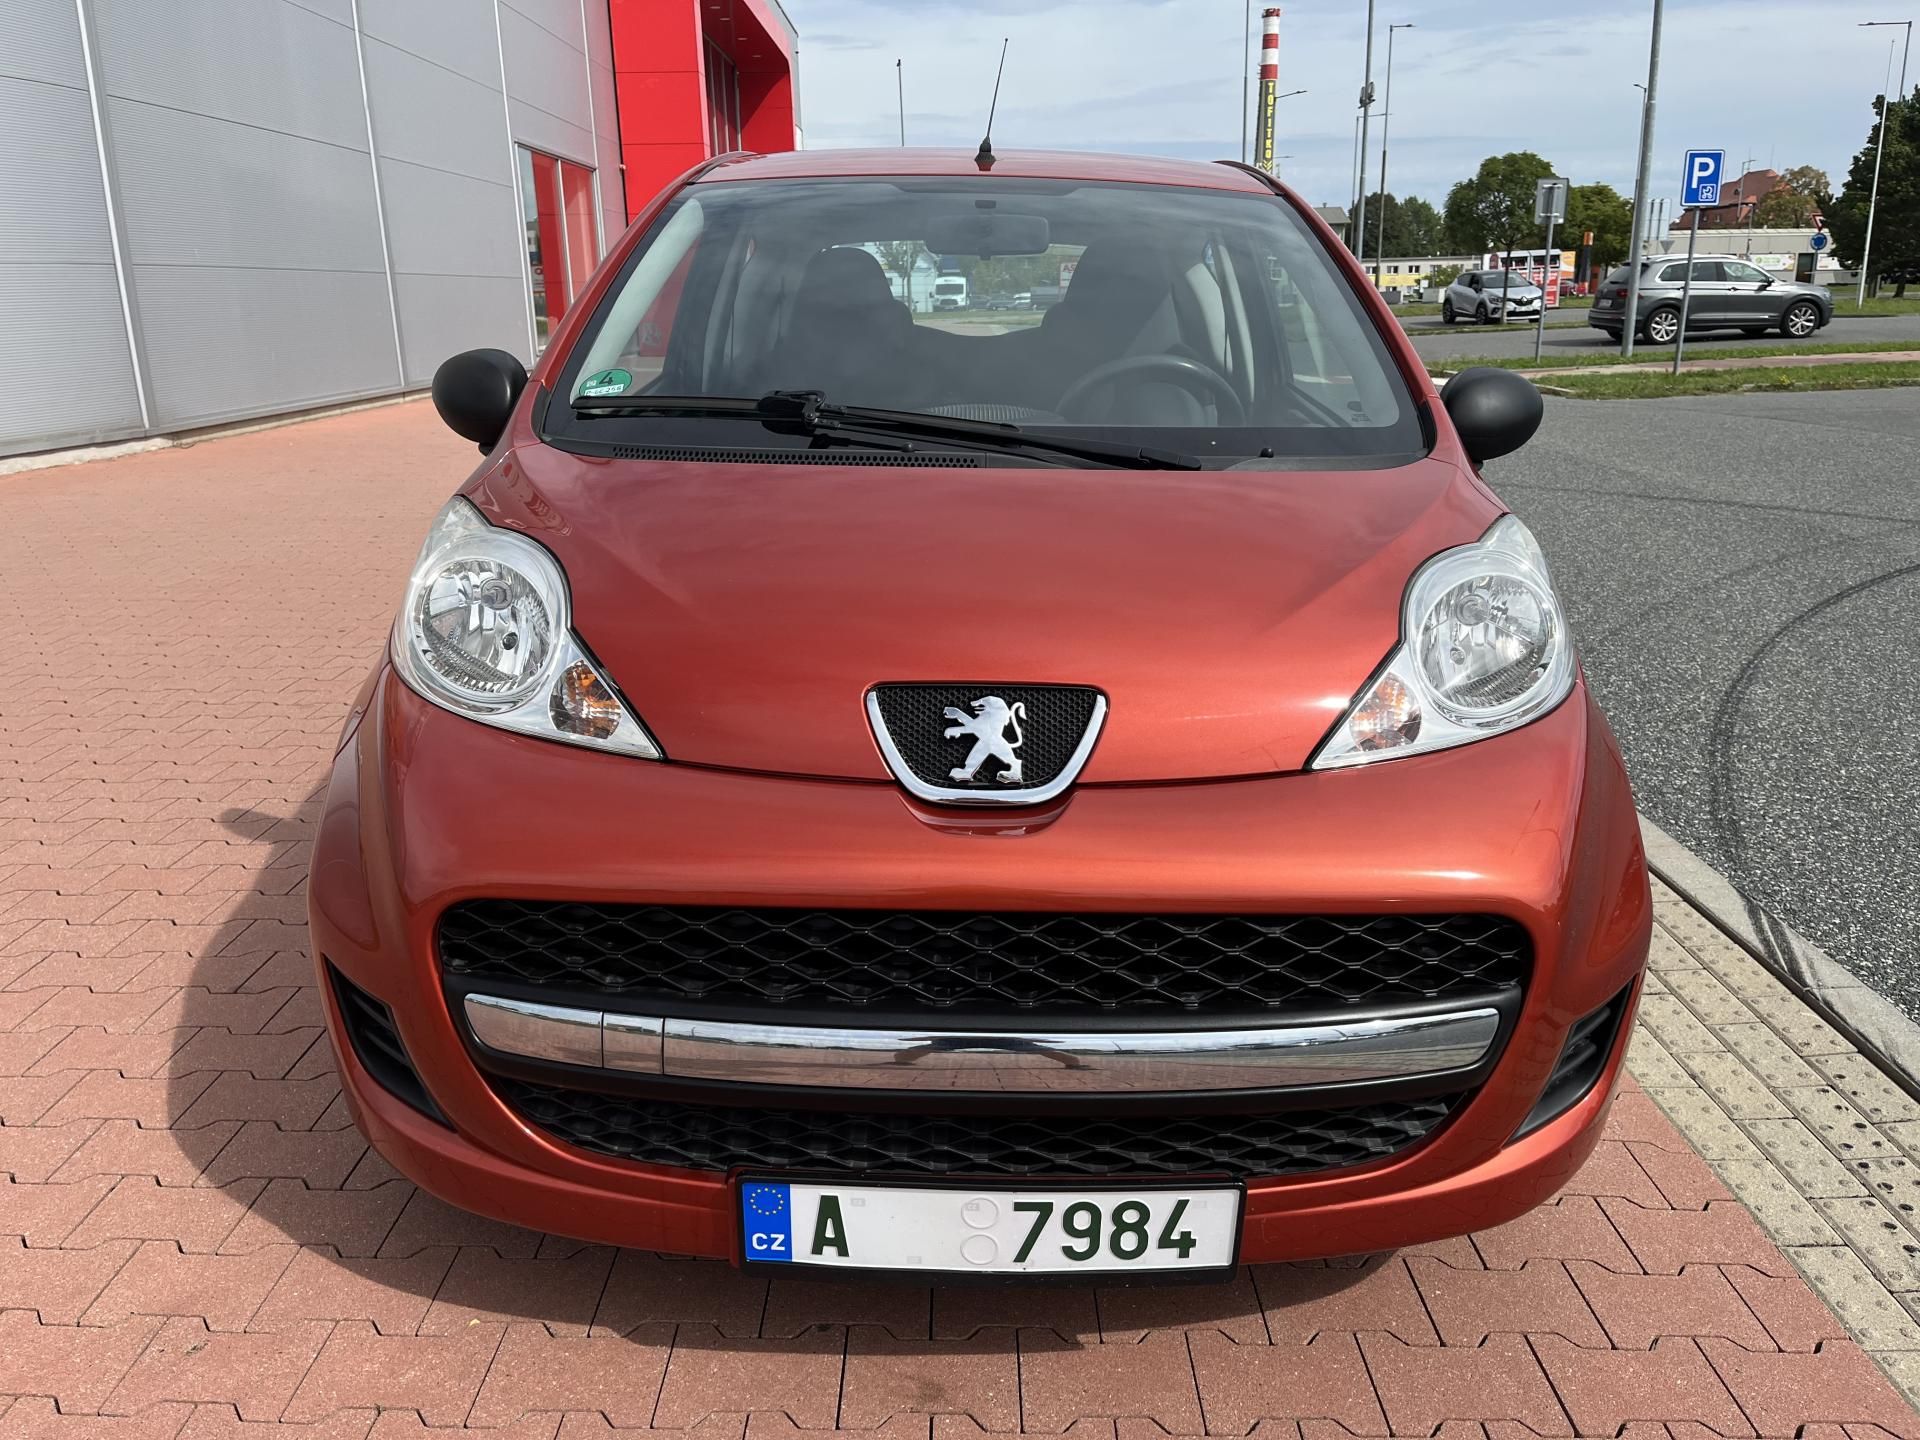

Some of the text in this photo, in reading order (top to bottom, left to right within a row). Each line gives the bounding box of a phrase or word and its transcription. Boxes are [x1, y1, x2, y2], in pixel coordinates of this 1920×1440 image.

[1265, 82, 1275, 158] TOFITKO
[1691, 157, 1715, 189] P
[600, 372, 613, 385] 4
[752, 1233, 785, 1251] CZ
[812, 1195, 1197, 1263] A 7984
